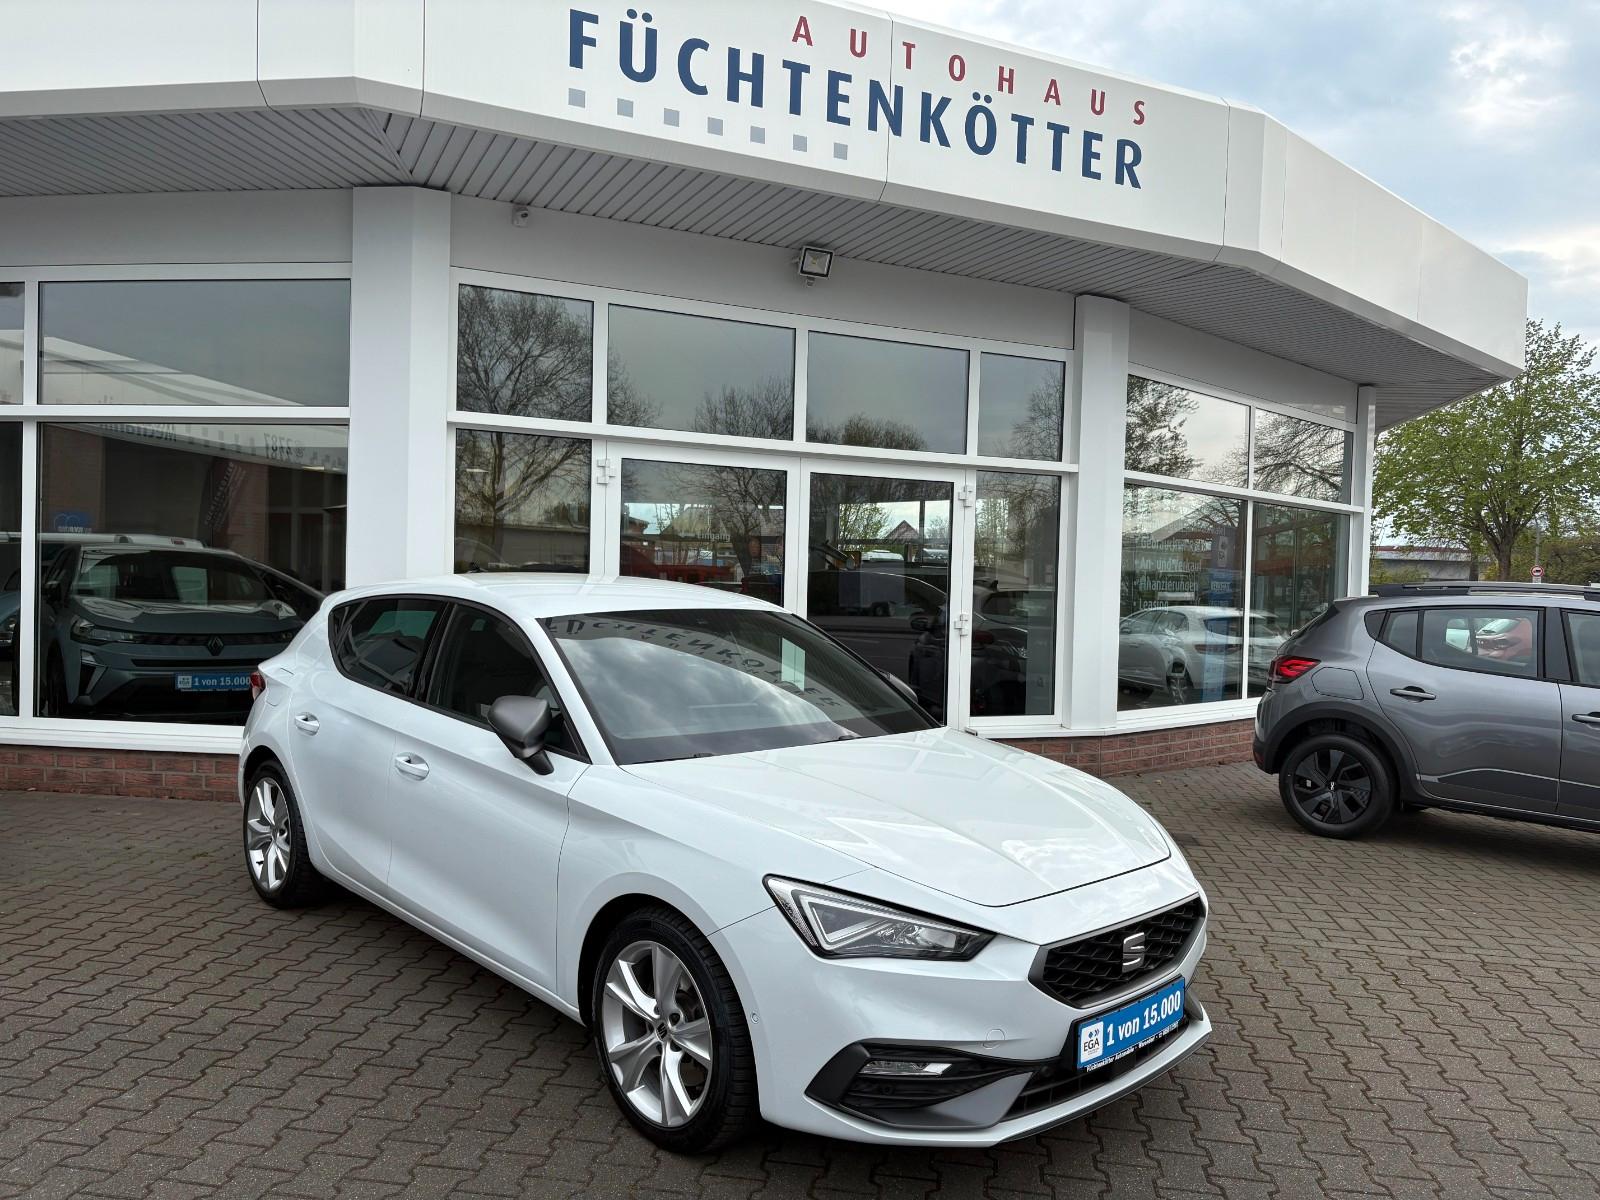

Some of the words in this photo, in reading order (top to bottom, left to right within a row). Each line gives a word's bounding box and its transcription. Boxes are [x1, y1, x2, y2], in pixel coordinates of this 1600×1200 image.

[568, 8, 1143, 190] FÜCHTENKÖTTER
[791, 15, 1146, 126] AUTOHAUS
[201, 678, 218, 686] von
[220, 676, 251, 686] 15.000
[1083, 1038, 1100, 1052] EGA
[1107, 1023, 1115, 1047] 1
[1118, 1017, 1140, 1041] von
[1143, 990, 1181, 1029] 15.000
